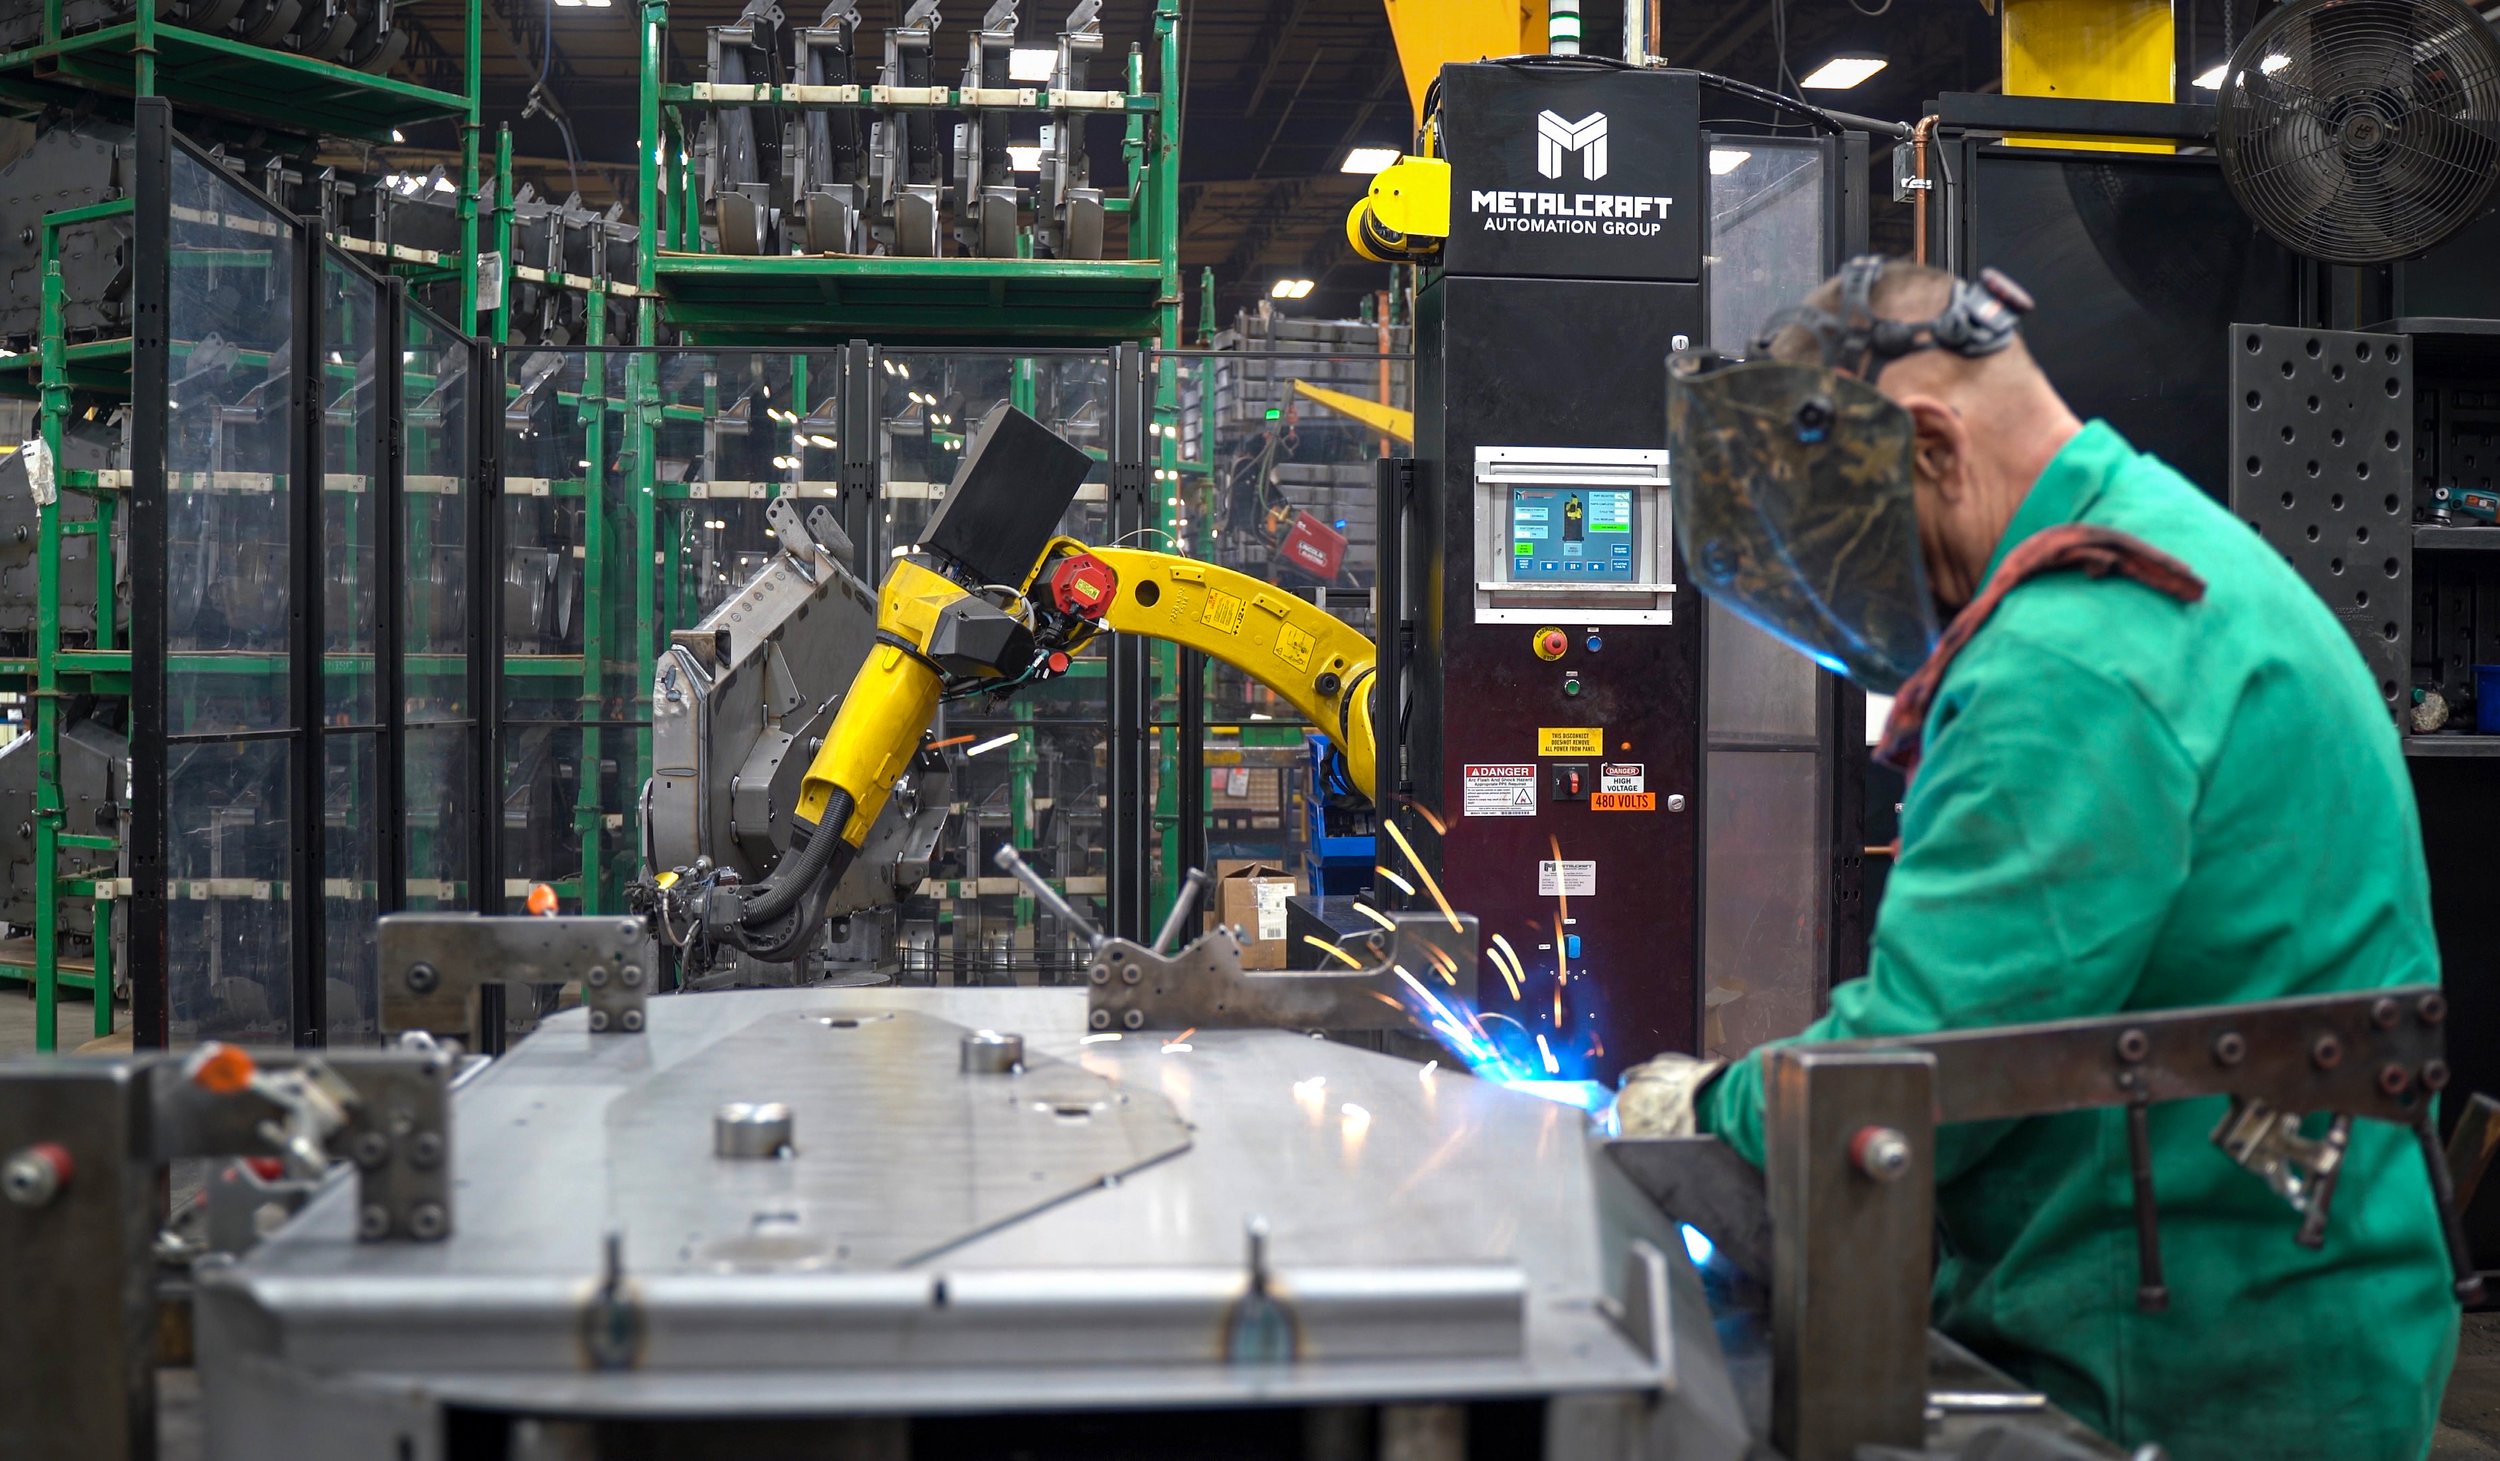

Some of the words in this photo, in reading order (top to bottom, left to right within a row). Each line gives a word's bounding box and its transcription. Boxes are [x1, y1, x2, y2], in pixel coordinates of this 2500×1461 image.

[1471, 190, 1672, 219] METALCRAFT
[1484, 217, 1597, 234] AUTOMATION
[1602, 220, 1661, 237] GROUP
[1481, 767, 1529, 776] DANGER
[1596, 794, 1615, 808] 480
[1618, 794, 1648, 808] VOLTS
